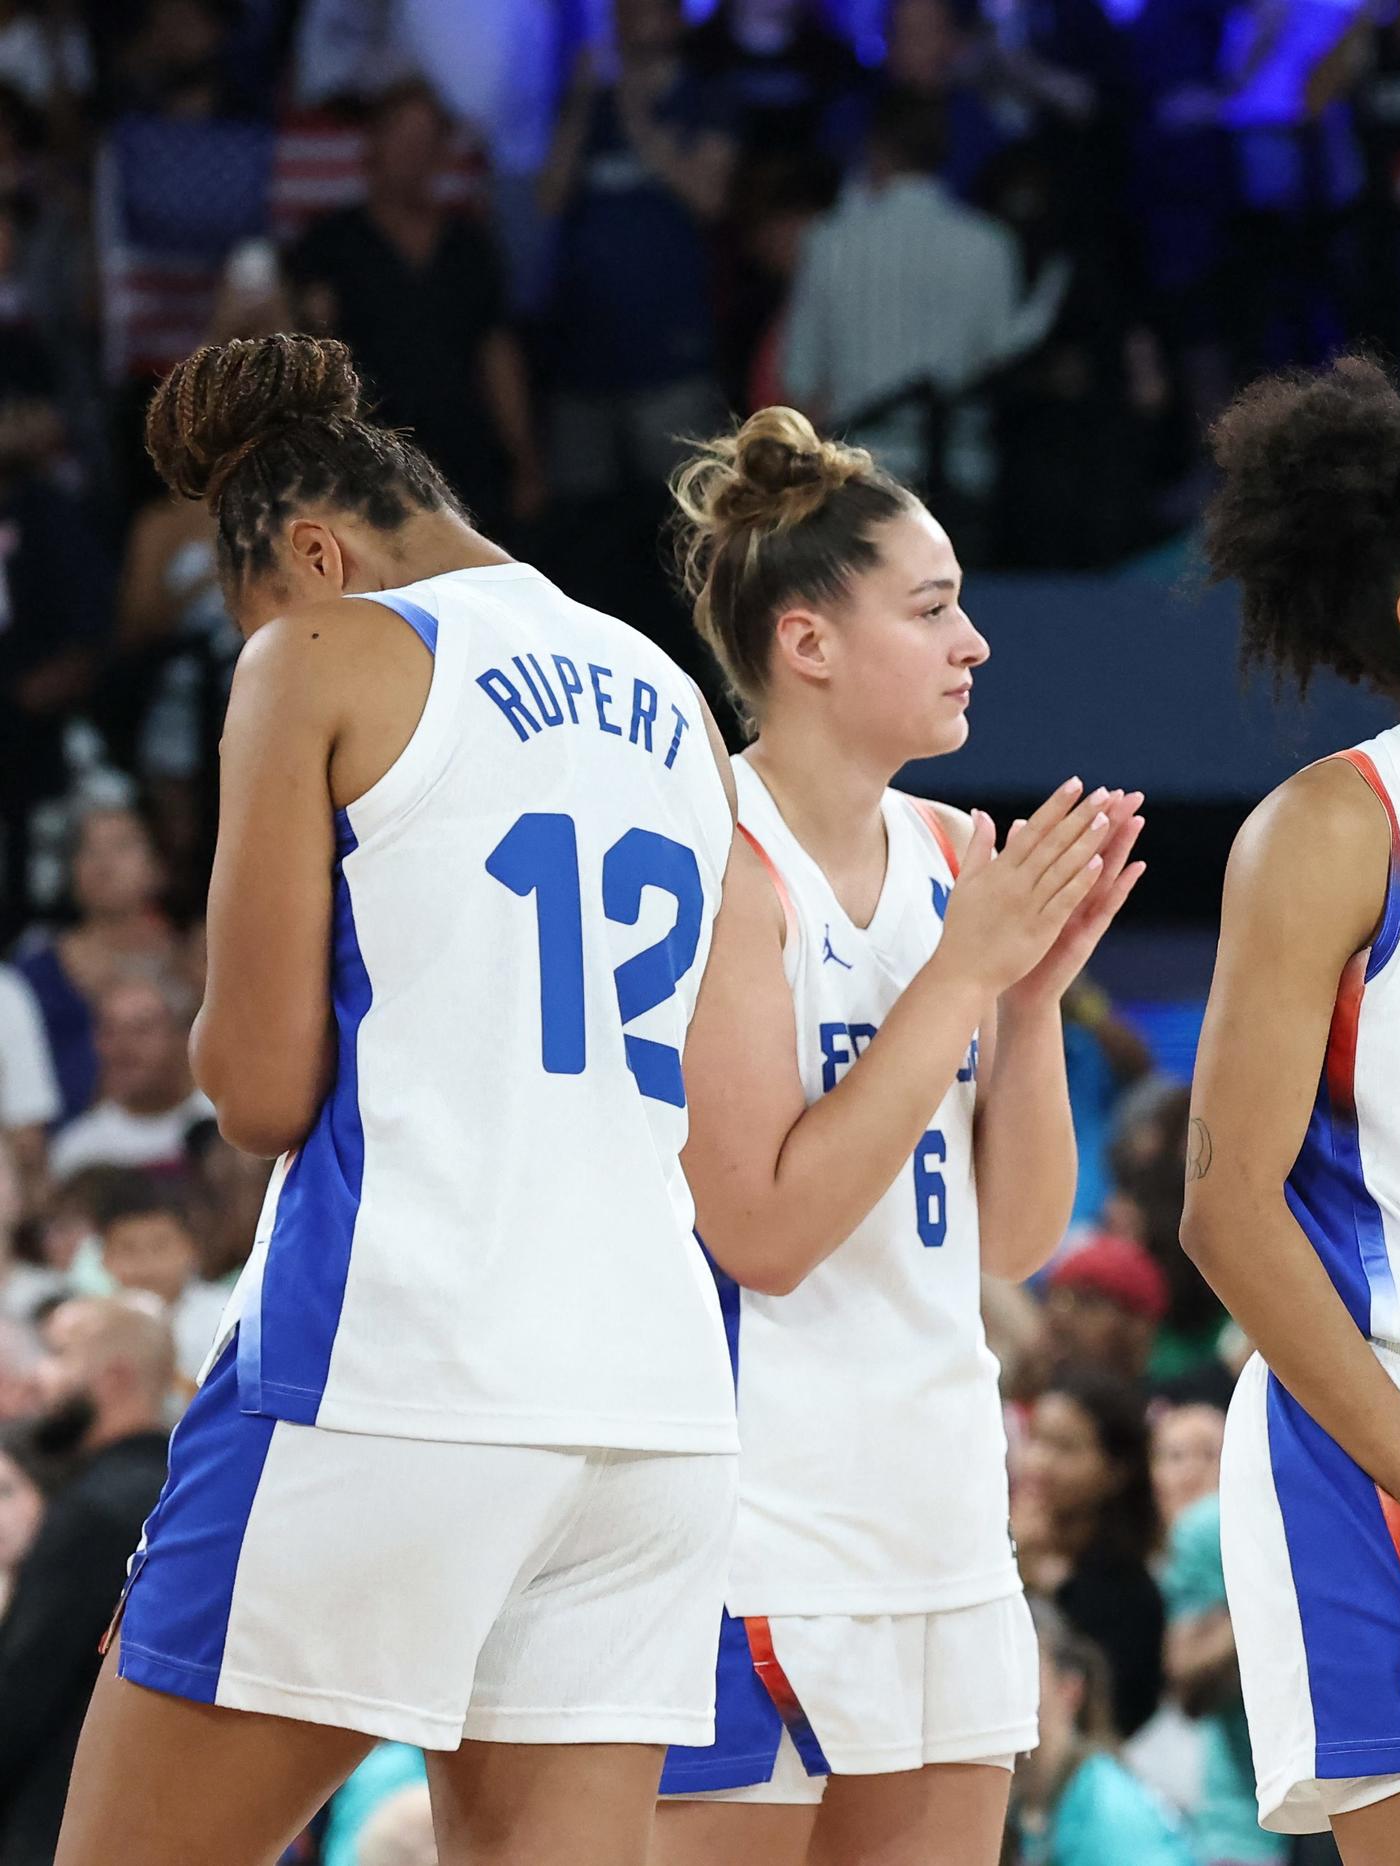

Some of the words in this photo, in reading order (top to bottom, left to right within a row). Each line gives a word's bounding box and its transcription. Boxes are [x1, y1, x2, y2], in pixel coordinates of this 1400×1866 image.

[475, 653, 690, 770] RUPERT
[484, 812, 704, 1109] 12
[913, 1129, 947, 1248] 6
